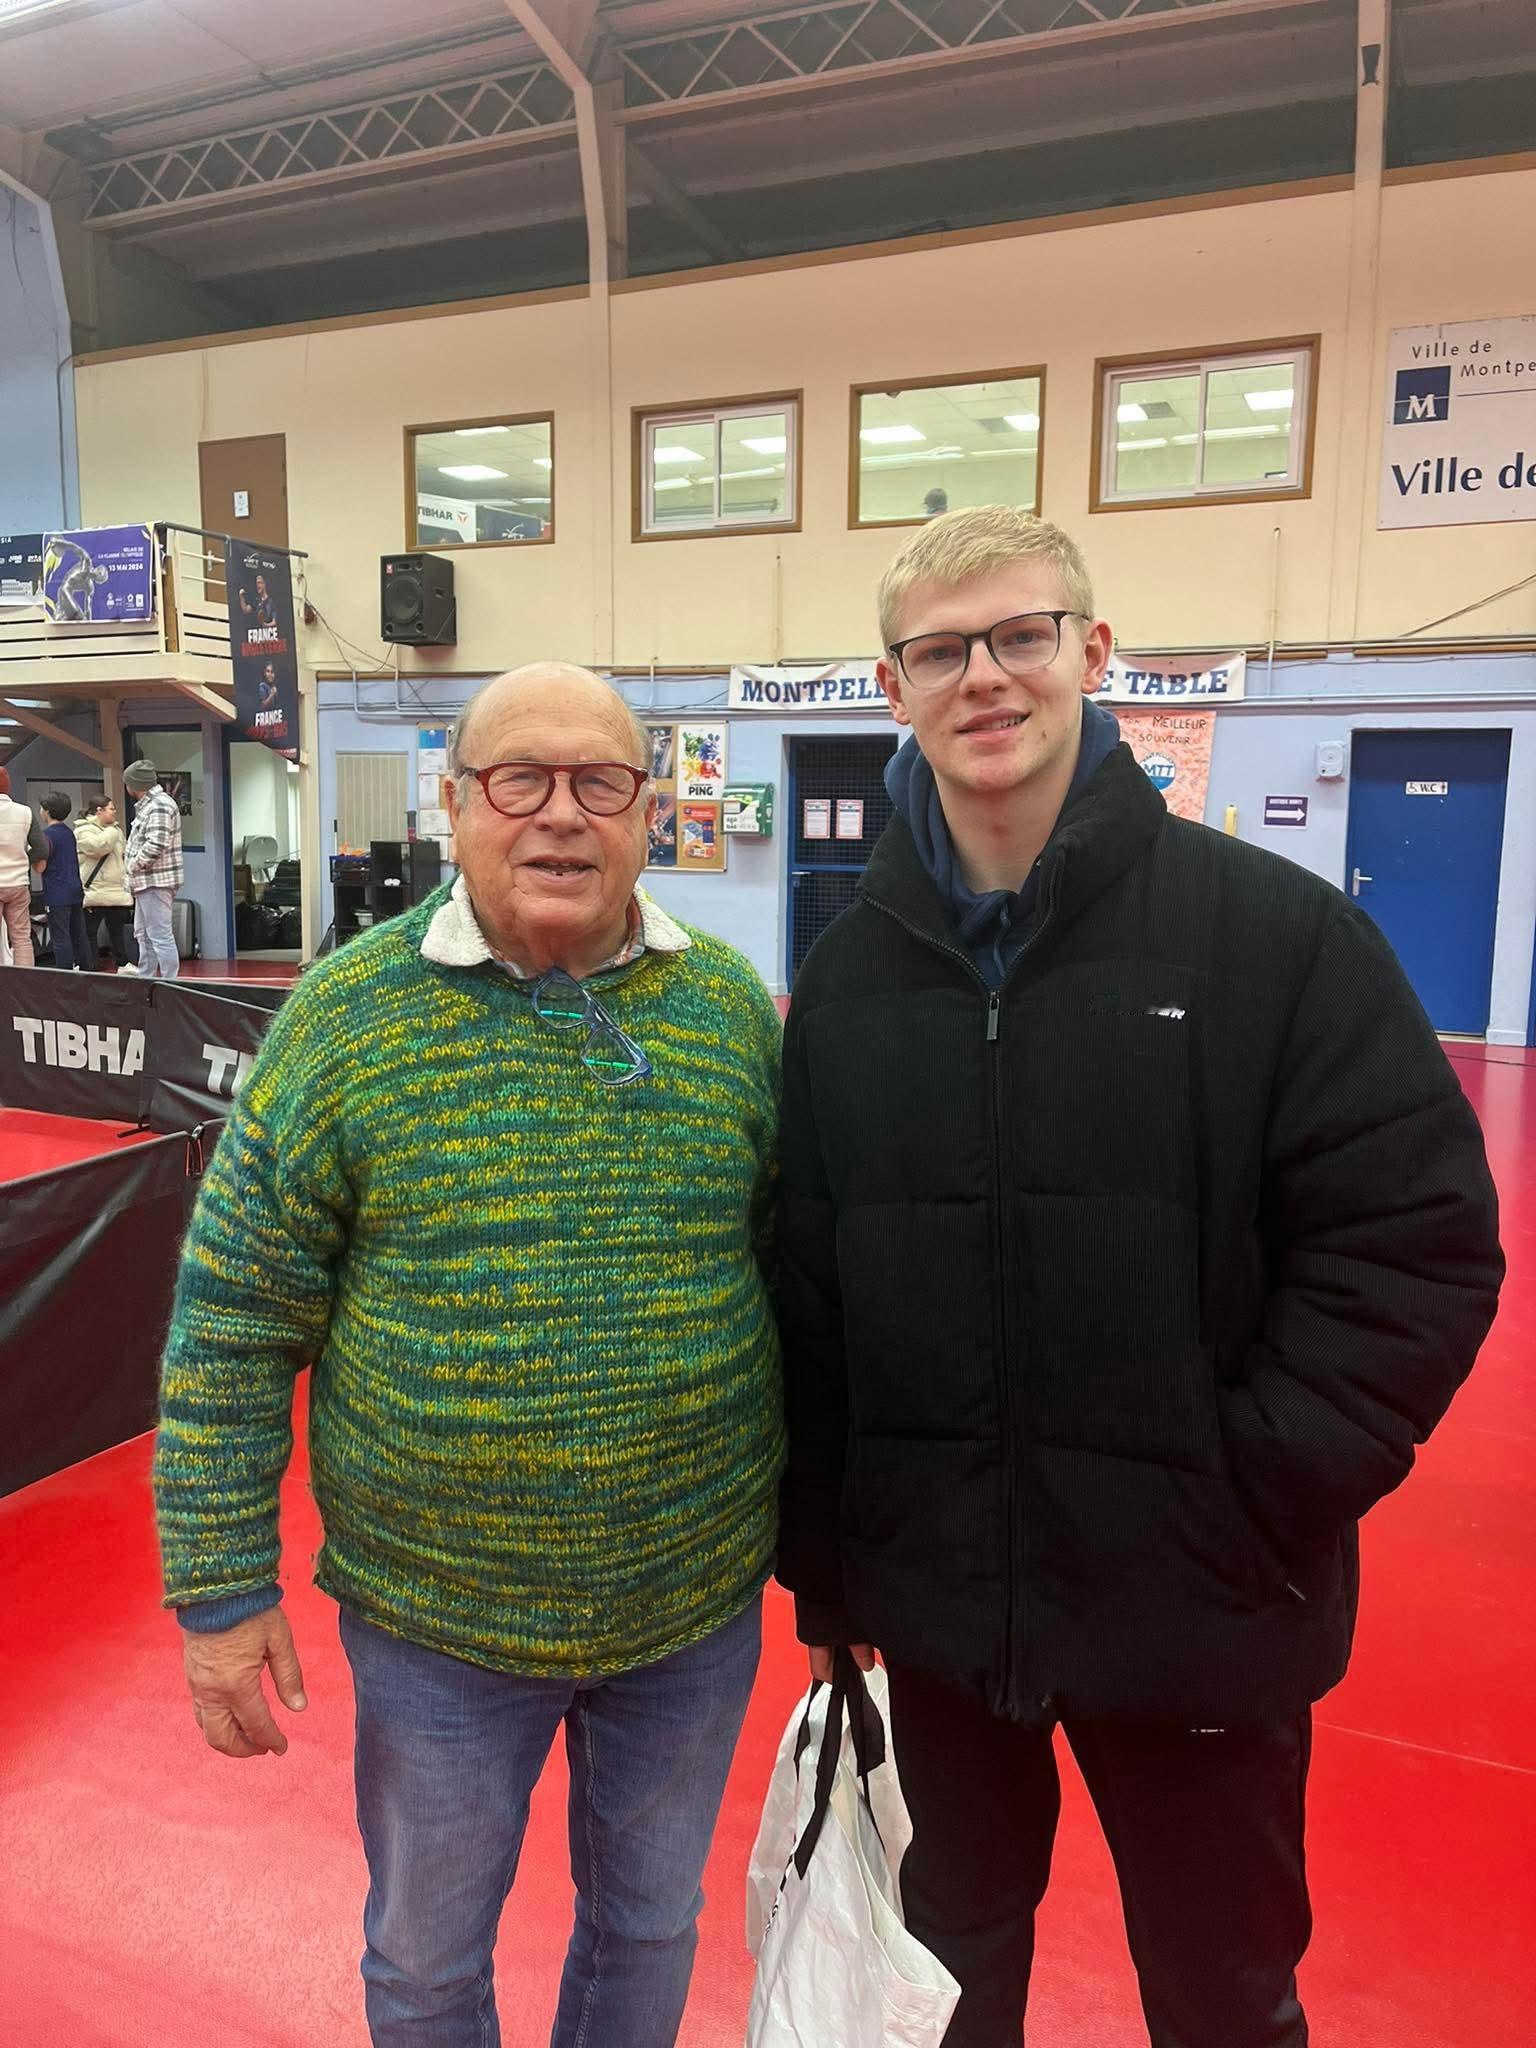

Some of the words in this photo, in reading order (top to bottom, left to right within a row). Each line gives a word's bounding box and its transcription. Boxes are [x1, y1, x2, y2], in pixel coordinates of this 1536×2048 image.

[1411, 341, 1459, 359] Ville
[1469, 340, 1492, 354] de
[1460, 359, 1536, 378] Montpe
[1391, 456, 1483, 496] Ville
[247, 626, 278, 643] FRANCE
[1124, 669, 1229, 696] TABLE
[254, 709, 283, 727] FRANCE
[1152, 715, 1207, 730] MEILLEUR
[1138, 733, 1191, 745] SOUVENIR
[1143, 764, 1175, 777] MTT
[688, 786, 713, 796] PING
